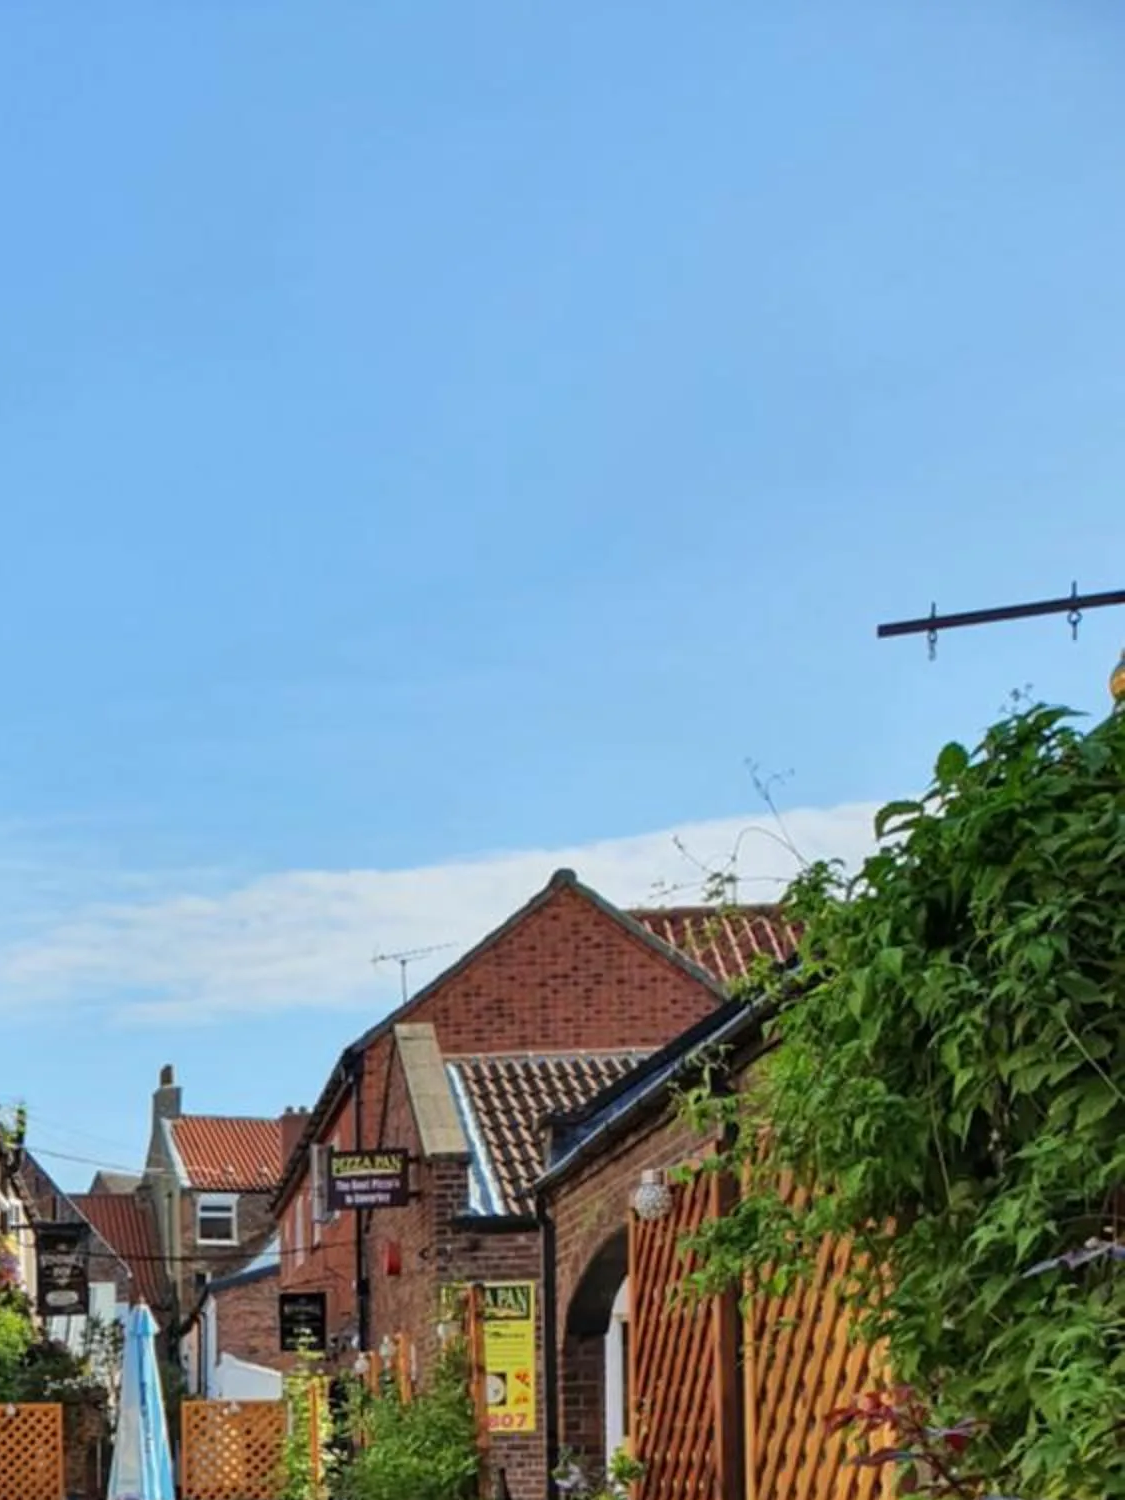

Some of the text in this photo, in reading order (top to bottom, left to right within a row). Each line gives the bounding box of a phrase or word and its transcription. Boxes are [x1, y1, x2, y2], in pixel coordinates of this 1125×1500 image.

[331, 1154, 402, 1177] PIZZA PAN
[496, 1287, 527, 1314] PAN
